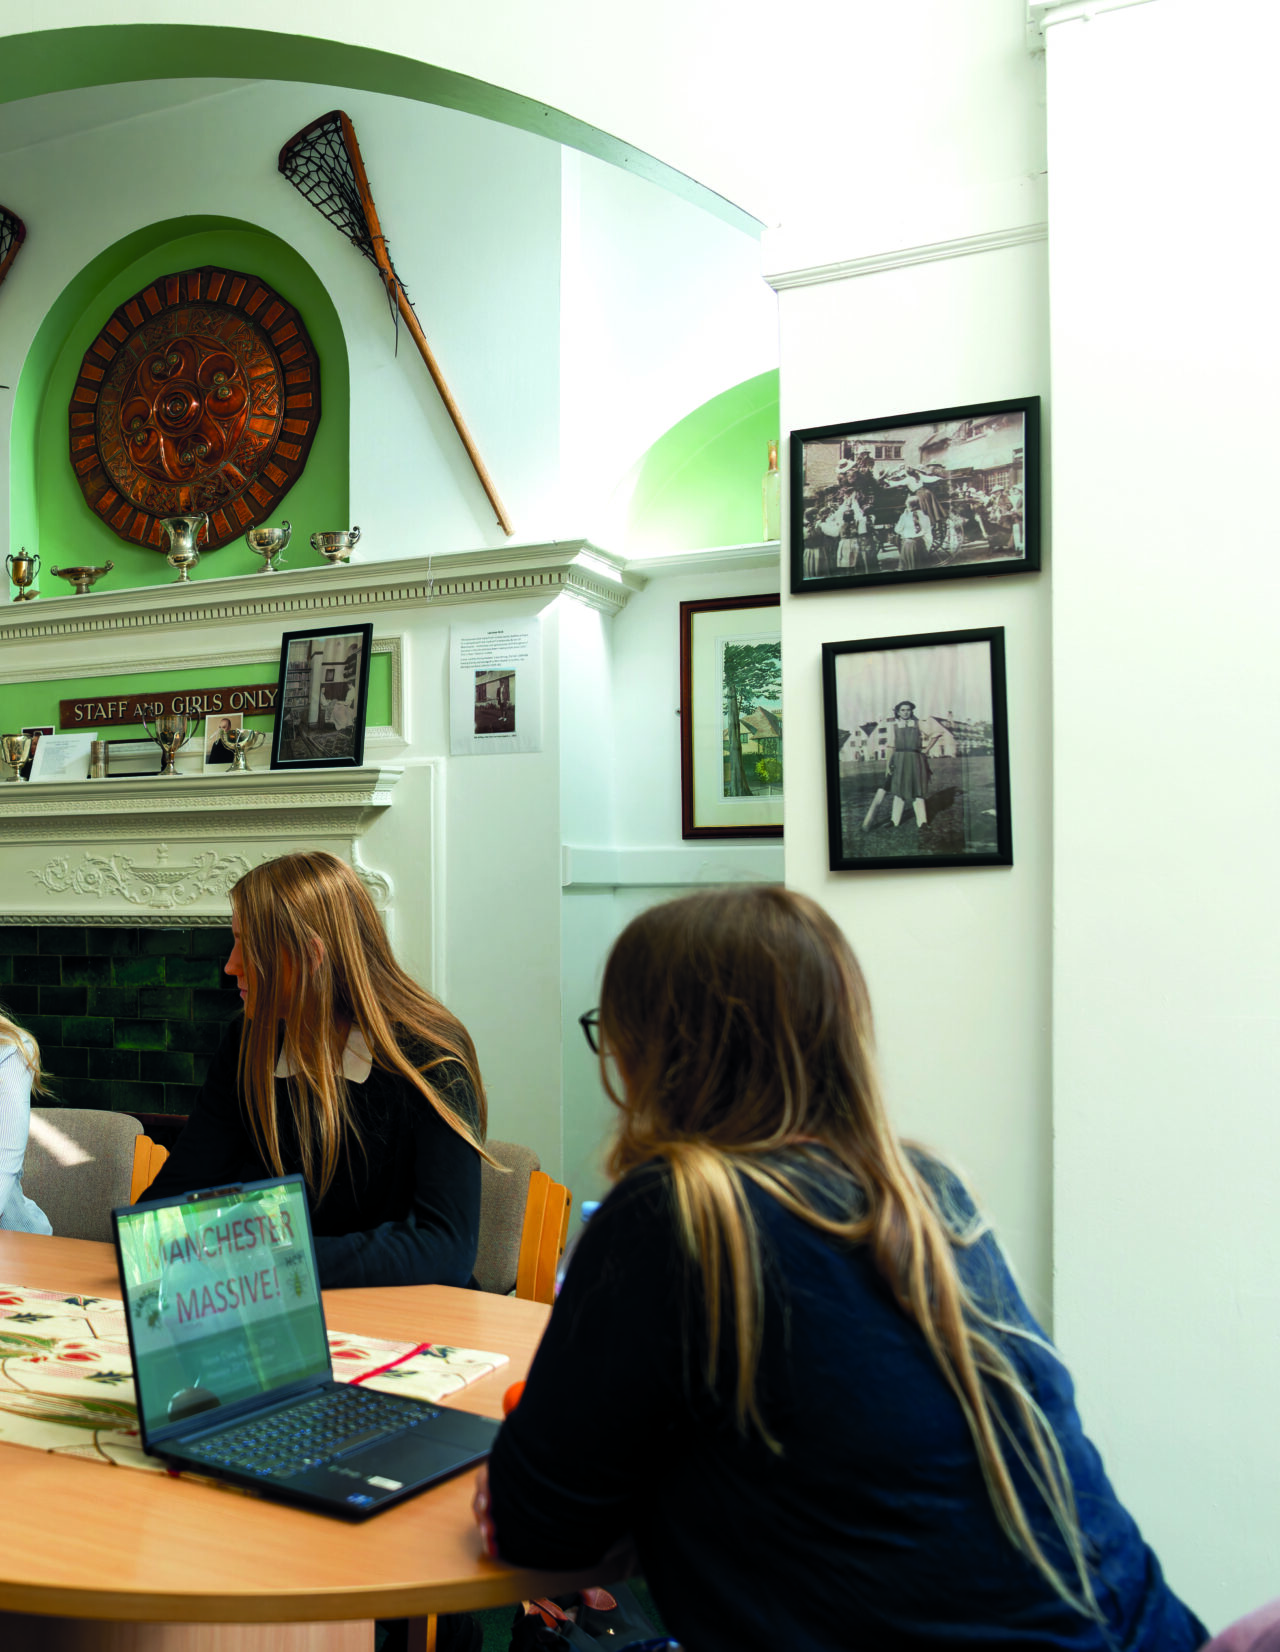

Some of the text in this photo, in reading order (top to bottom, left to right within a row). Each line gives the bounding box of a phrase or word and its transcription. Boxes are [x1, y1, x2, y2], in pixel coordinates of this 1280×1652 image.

[74, 689, 278, 721] STAFF AND GIRLS ONLY
[144, 1211, 295, 1272] MANCHESTER
[176, 1267, 281, 1323] MASSIVE!
